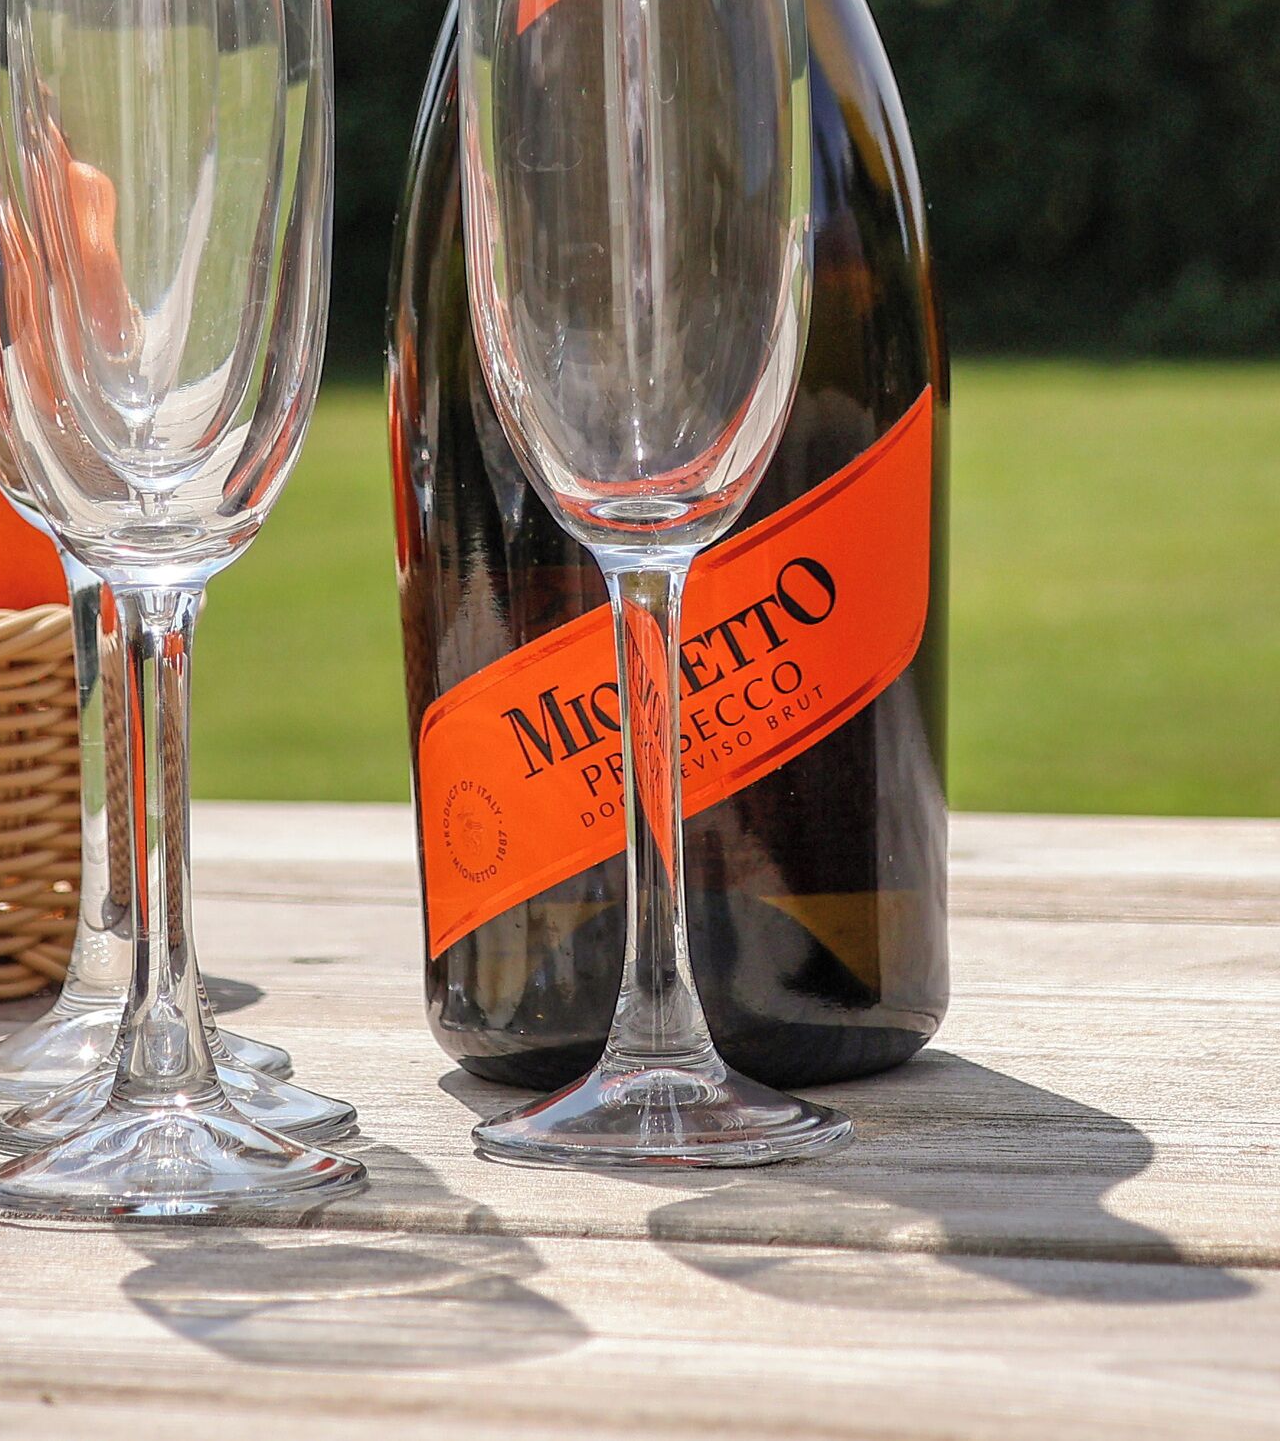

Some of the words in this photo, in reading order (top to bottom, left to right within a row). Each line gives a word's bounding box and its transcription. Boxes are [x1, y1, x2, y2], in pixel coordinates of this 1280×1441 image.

[500, 556, 837, 779] MIOETTO
[581, 660, 803, 797] PRECCO
[681, 730, 752, 779] EVISO
[766, 684, 824, 731] BRUT
[443, 784, 459, 847] PRODUCT
[460, 780, 474, 792] OF
[477, 785, 502, 815] ITALY
[452, 857, 497, 883] MIONETTO
[496, 830, 508, 862] 1887
